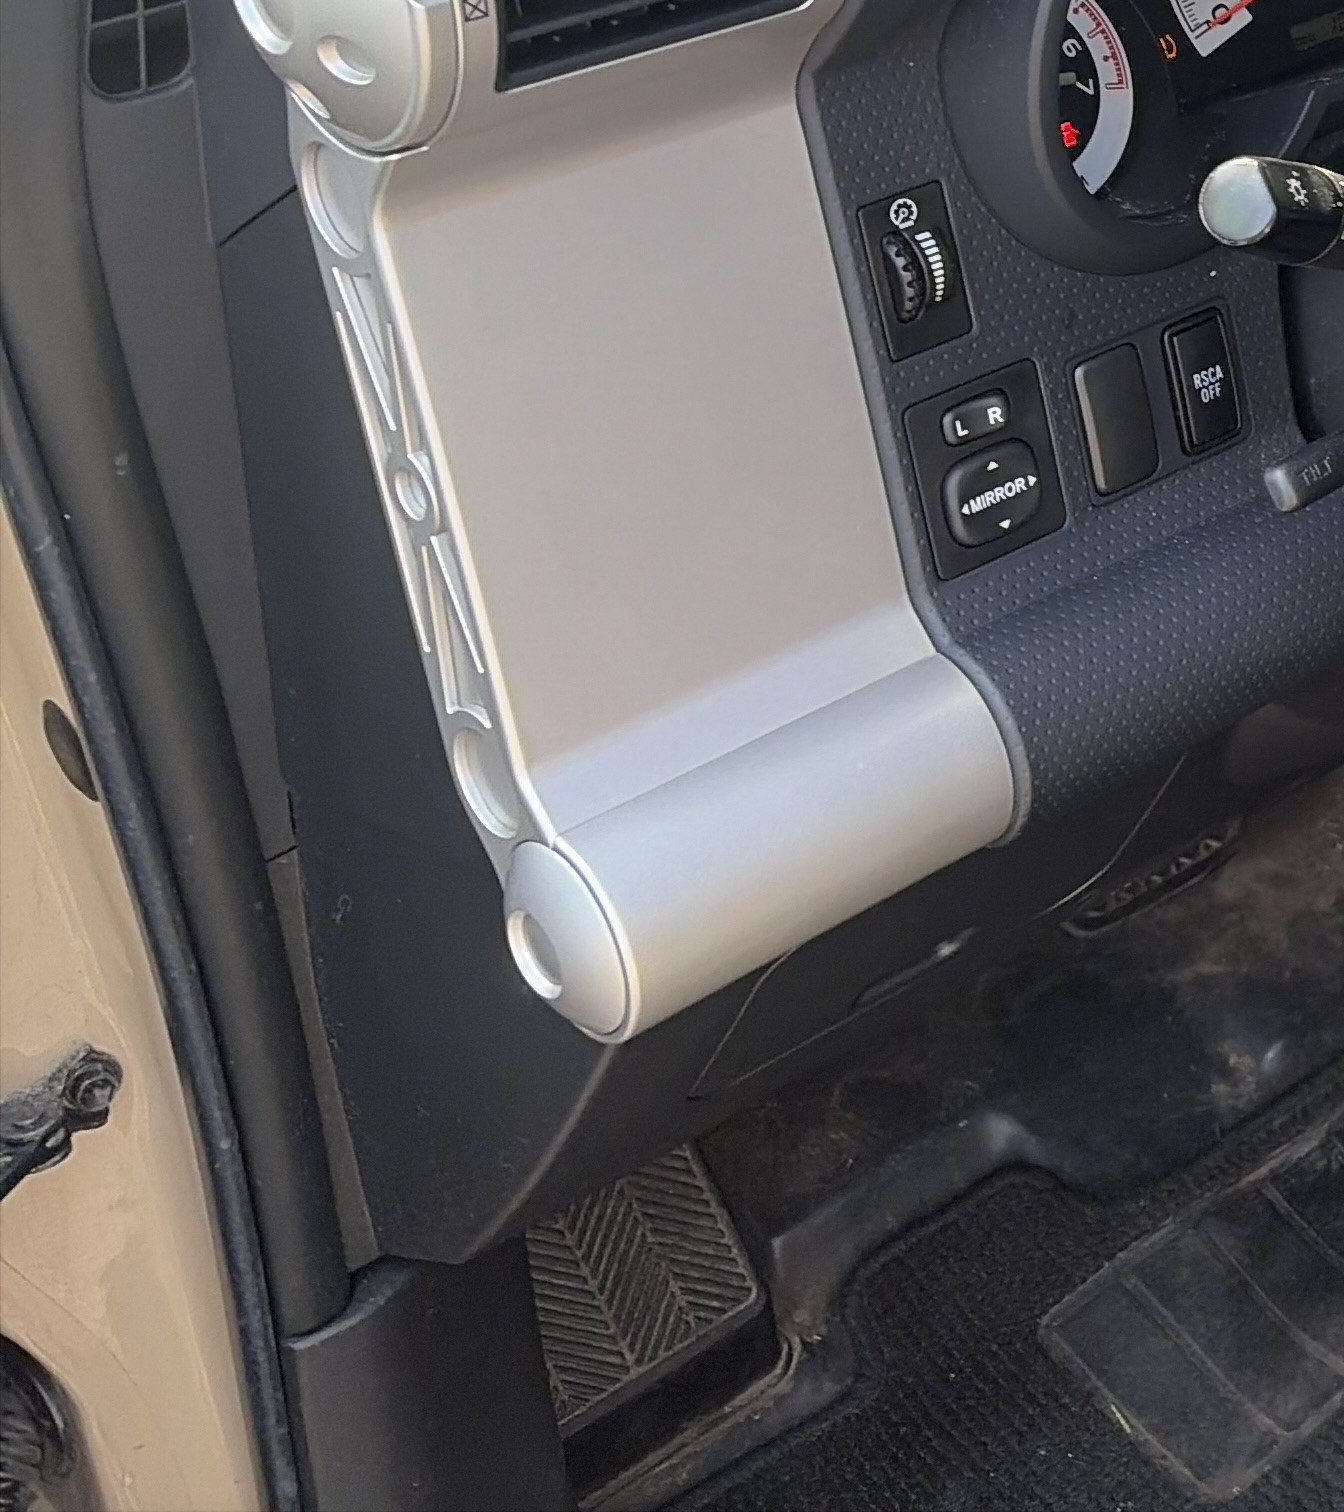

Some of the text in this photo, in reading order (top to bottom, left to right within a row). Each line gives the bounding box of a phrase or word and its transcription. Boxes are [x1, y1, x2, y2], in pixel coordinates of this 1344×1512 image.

[1061, 38, 1082, 58] 6
[1075, 78, 1095, 96] 7
[1192, 364, 1224, 389] RSCA
[1201, 382, 1221, 403] OFF
[955, 407, 1005, 437] L R
[969, 477, 1028, 514] MIRROR
